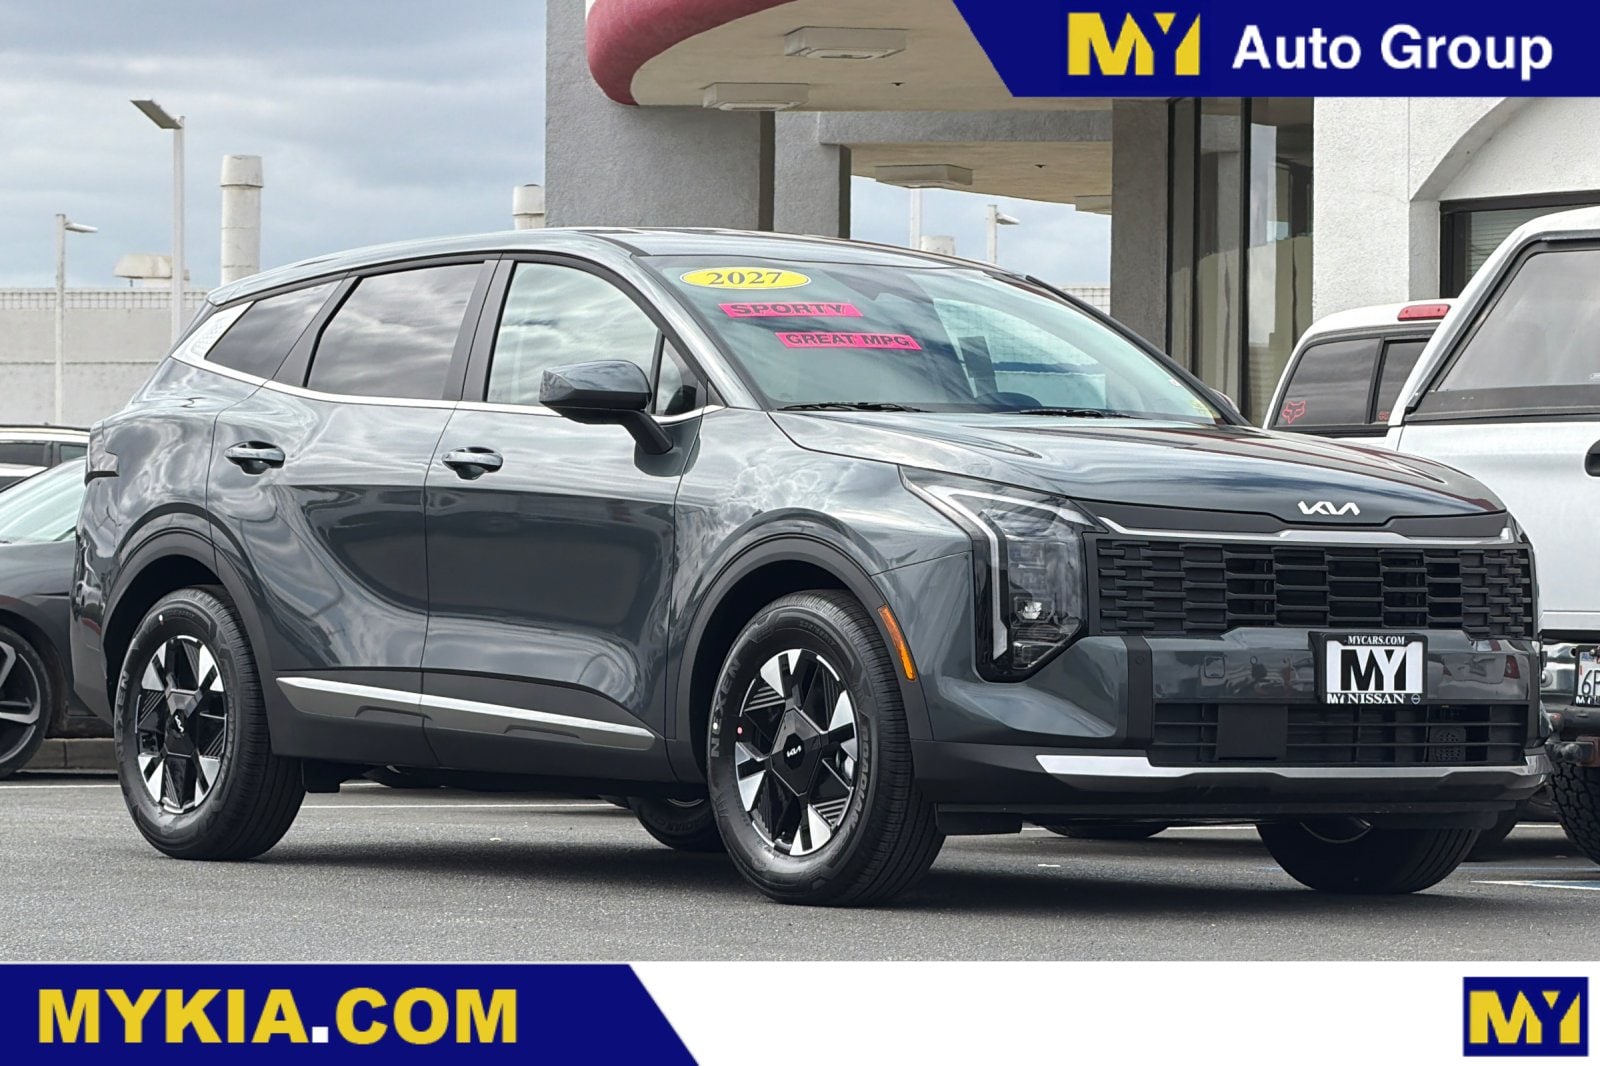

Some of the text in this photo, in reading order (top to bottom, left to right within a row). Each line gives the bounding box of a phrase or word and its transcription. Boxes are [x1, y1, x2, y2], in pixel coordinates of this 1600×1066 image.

[705, 271, 783, 285] 2027
[729, 303, 845, 315] SPORTY
[785, 333, 911, 347] GREAT MPG
[1297, 500, 1361, 516] KIA
[1347, 635, 1405, 645] MYCARS.COM
[1340, 648, 1407, 692] MY
[1326, 693, 1405, 704] MY NISSAN
[710, 658, 740, 757] NEXEN
